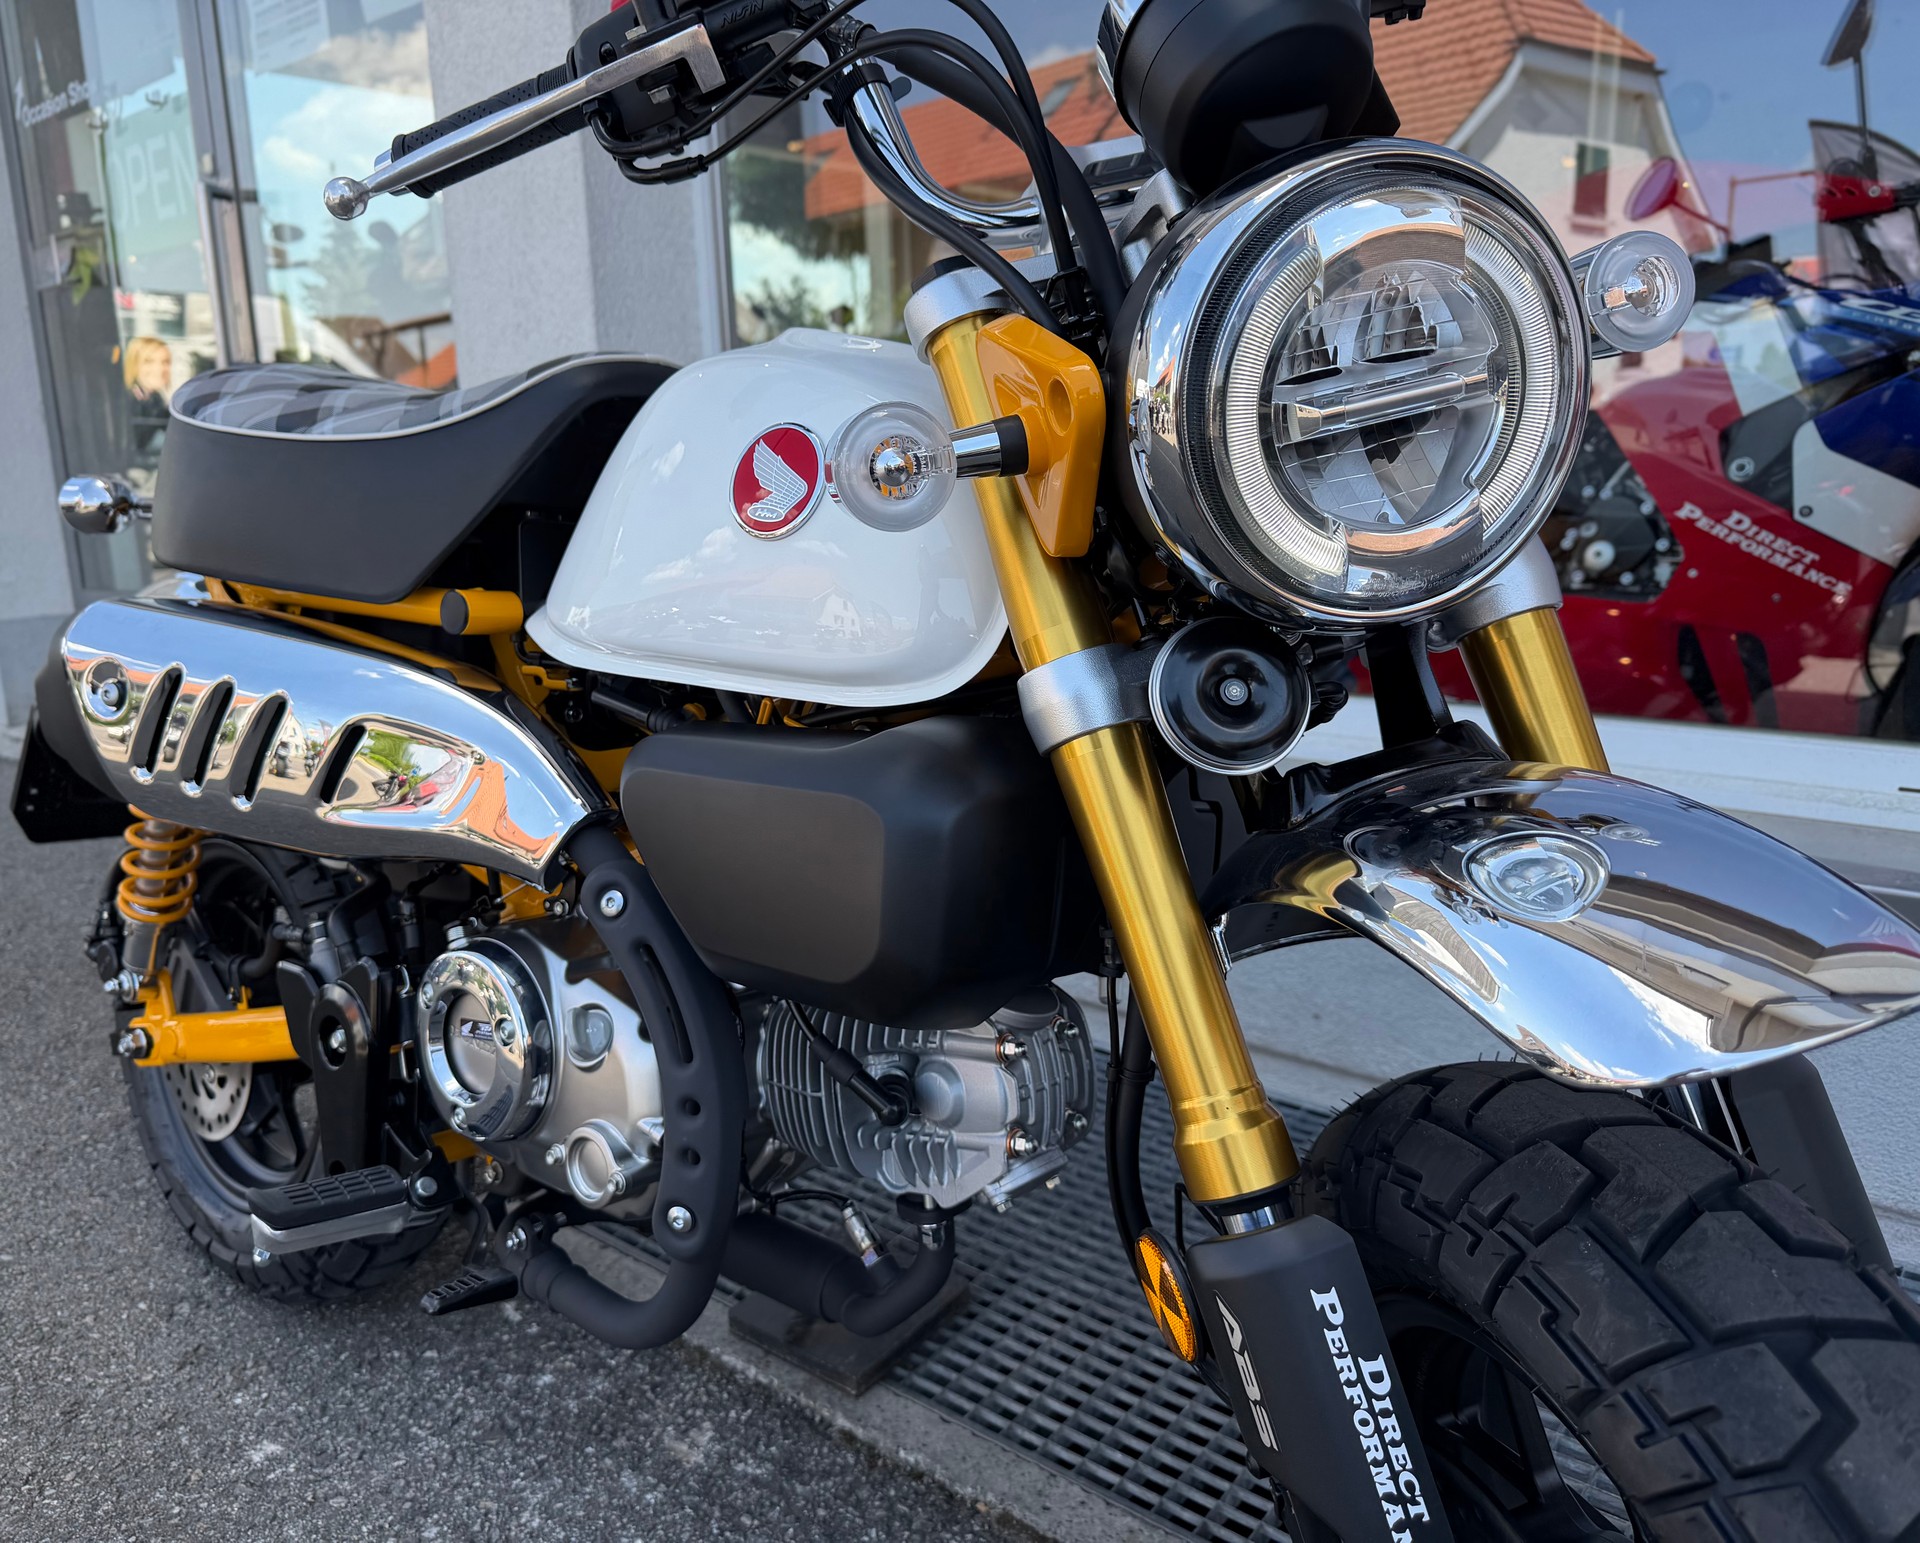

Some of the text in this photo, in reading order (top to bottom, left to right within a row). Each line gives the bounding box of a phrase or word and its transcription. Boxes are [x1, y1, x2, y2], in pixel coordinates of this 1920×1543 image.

[23, 93, 68, 127] Occasion
[1674, 501, 1852, 597] PERFORMANCE
[1722, 510, 1820, 564] DIRECT
[1215, 1295, 1279, 1451] ABS
[1358, 1354, 1430, 1521] DIRECT
